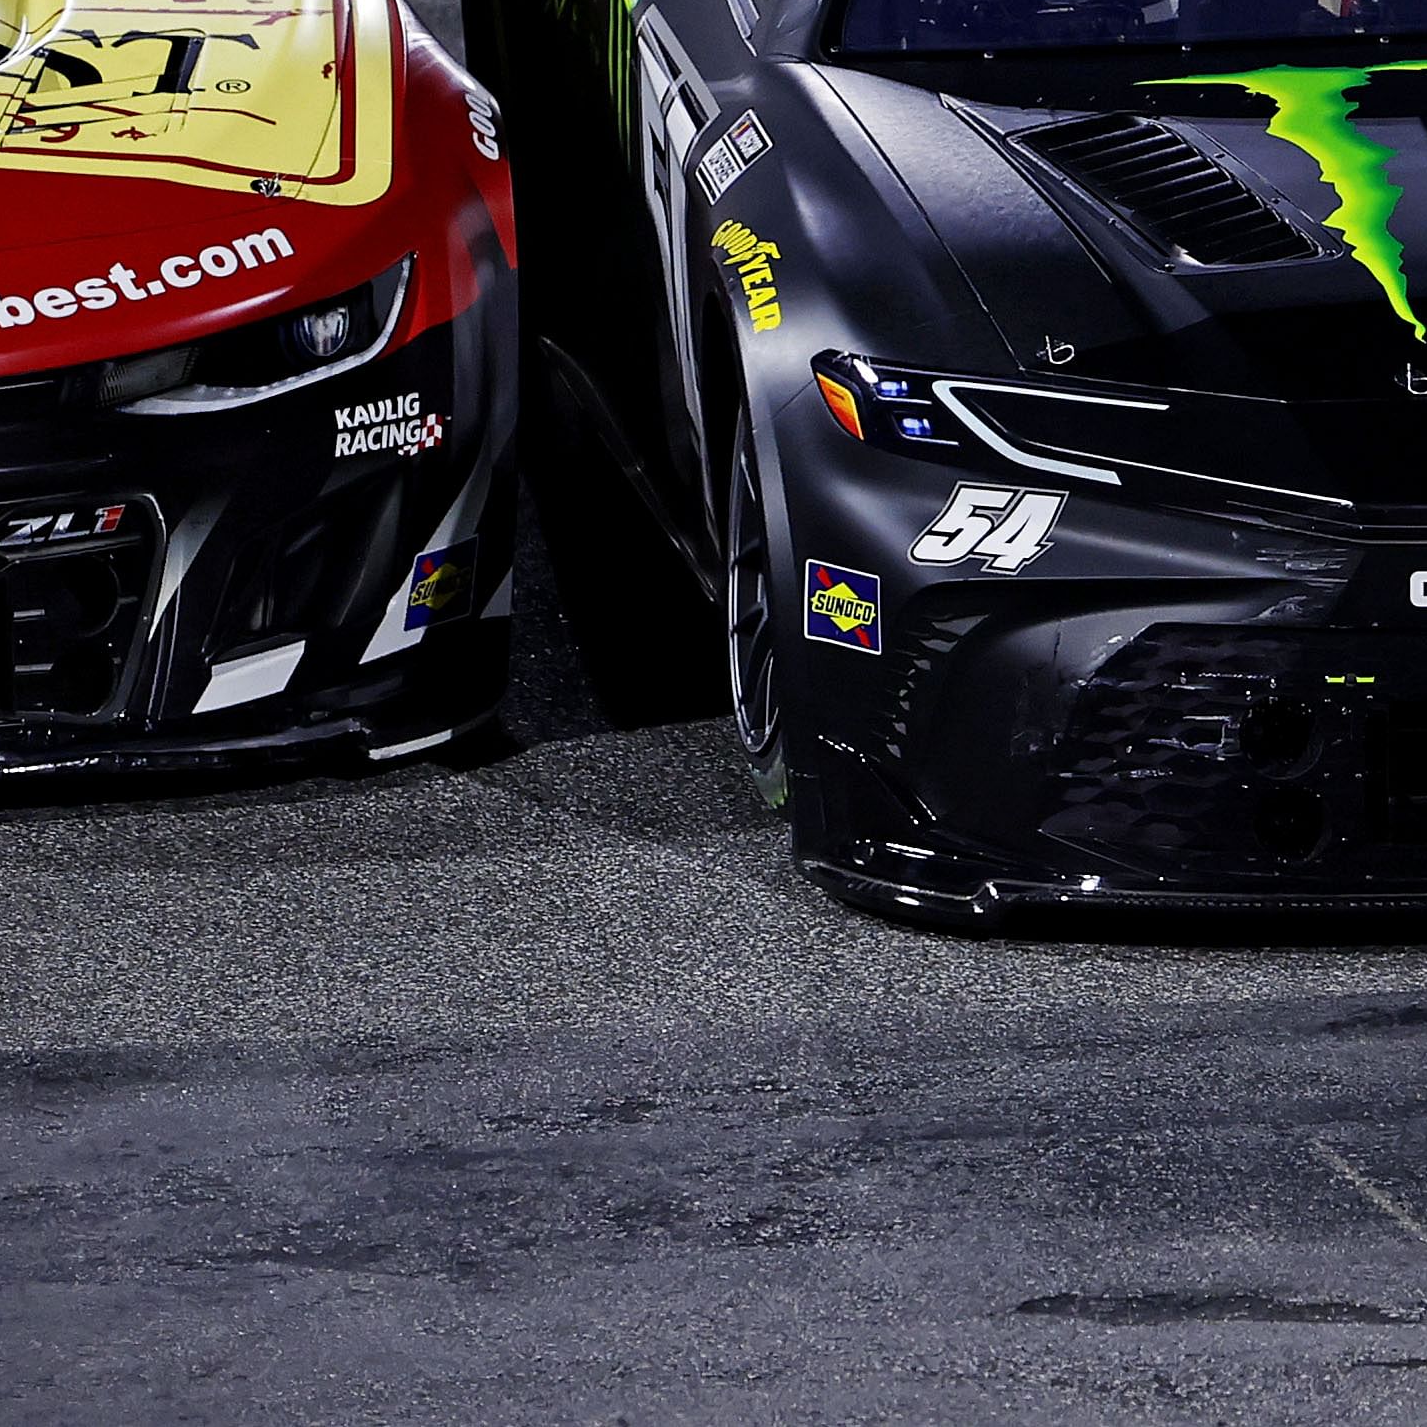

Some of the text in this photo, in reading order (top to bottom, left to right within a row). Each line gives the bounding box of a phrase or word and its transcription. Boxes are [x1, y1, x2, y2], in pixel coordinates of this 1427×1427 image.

[711, 219, 781, 333] GOODYEAR
[334, 392, 421, 430] KAULIG
[334, 418, 423, 458] RACING
[908, 480, 1071, 576] 54
[814, 592, 874, 623] SUNOCO
